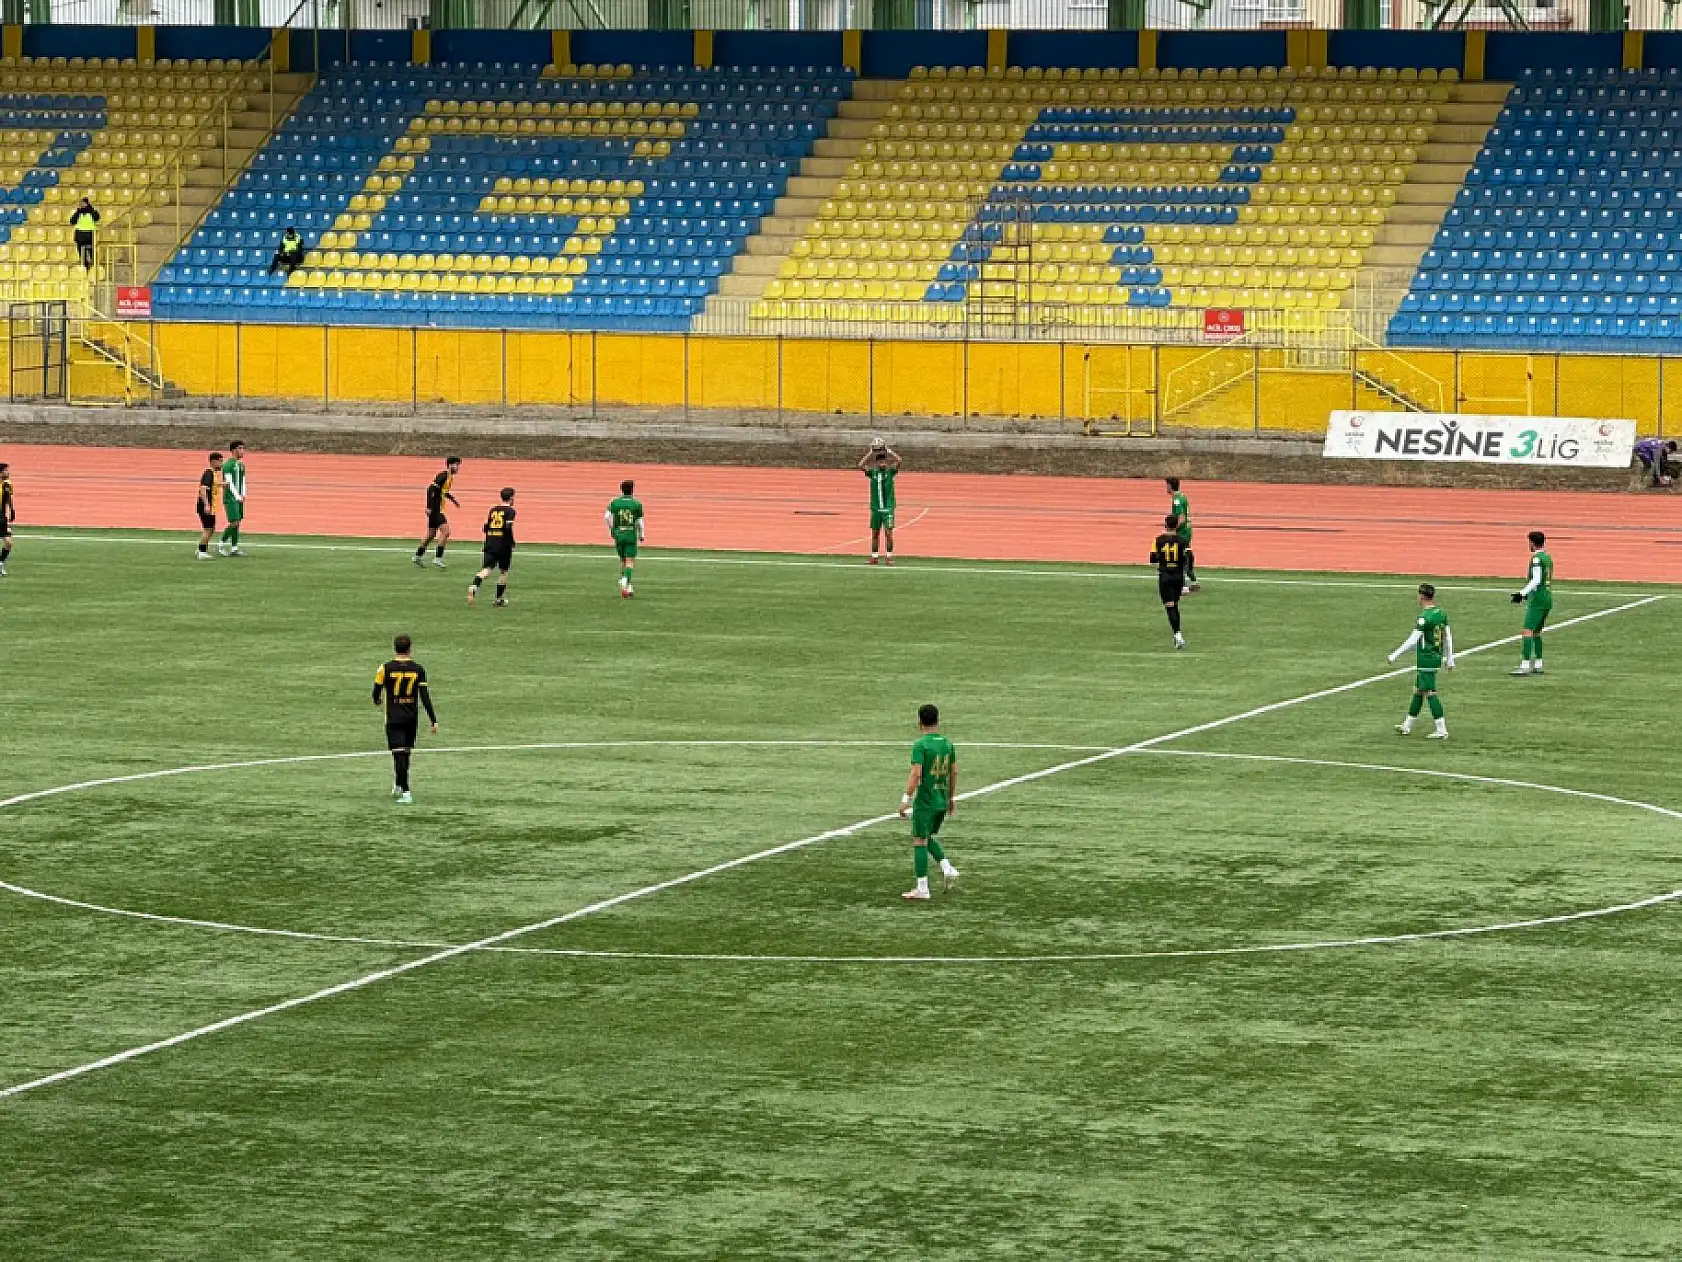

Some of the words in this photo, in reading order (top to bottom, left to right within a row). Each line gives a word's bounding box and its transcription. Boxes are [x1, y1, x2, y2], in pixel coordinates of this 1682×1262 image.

[1374, 420, 1504, 457] NESİNE
[1161, 541, 1179, 562] 11
[389, 671, 419, 697] 77
